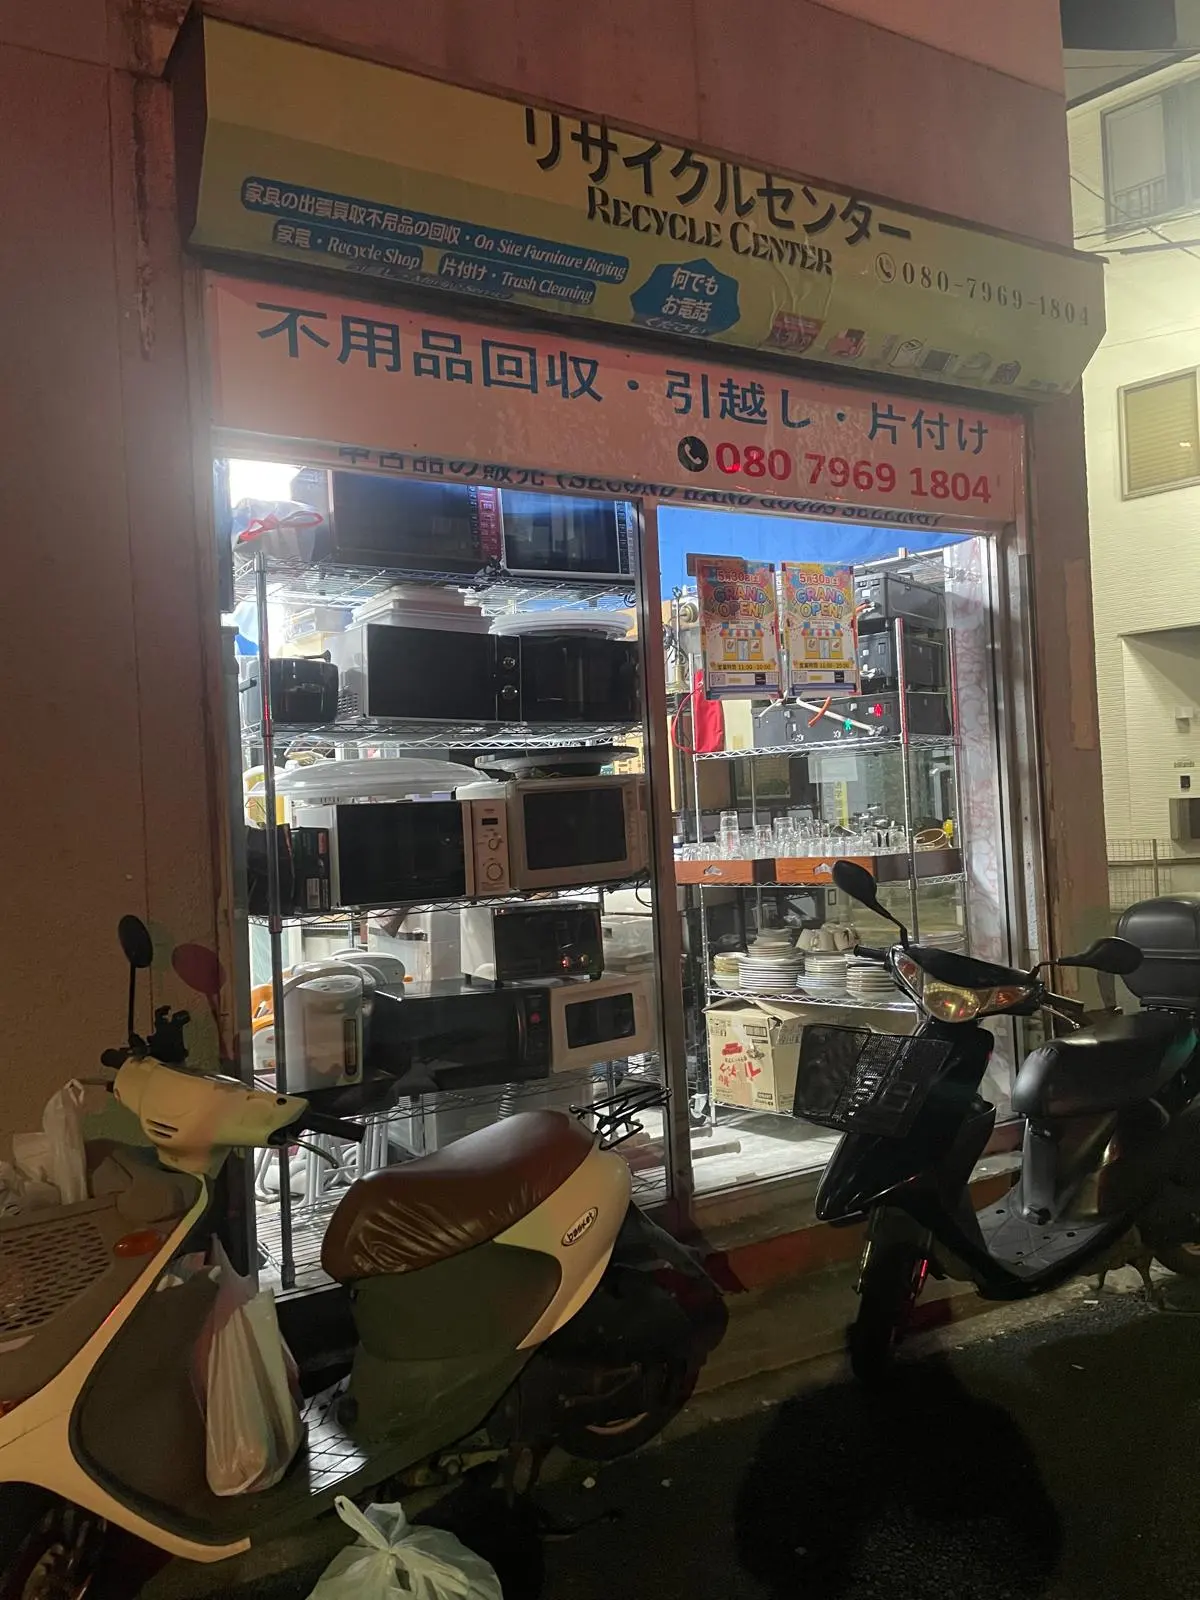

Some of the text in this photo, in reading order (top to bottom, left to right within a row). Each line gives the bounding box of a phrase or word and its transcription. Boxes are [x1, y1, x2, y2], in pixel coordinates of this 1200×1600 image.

[525, 107, 911, 245] リサイクルセンター
[587, 185, 833, 275] RECYCLE CENTER
[327, 236, 382, 262] Recycle
[383, 247, 420, 271] Shop
[501, 271, 537, 293] Trash
[538, 279, 594, 305] Cleaning
[670, 267, 719, 297] 何でも
[902, 261, 1089, 326] 080-7969-1804
[660, 295, 713, 323] お電話
[714, 442, 991, 503] 080 7969 1804
[713, 583, 767, 604] GRAND
[796, 586, 845, 605] GRAND
